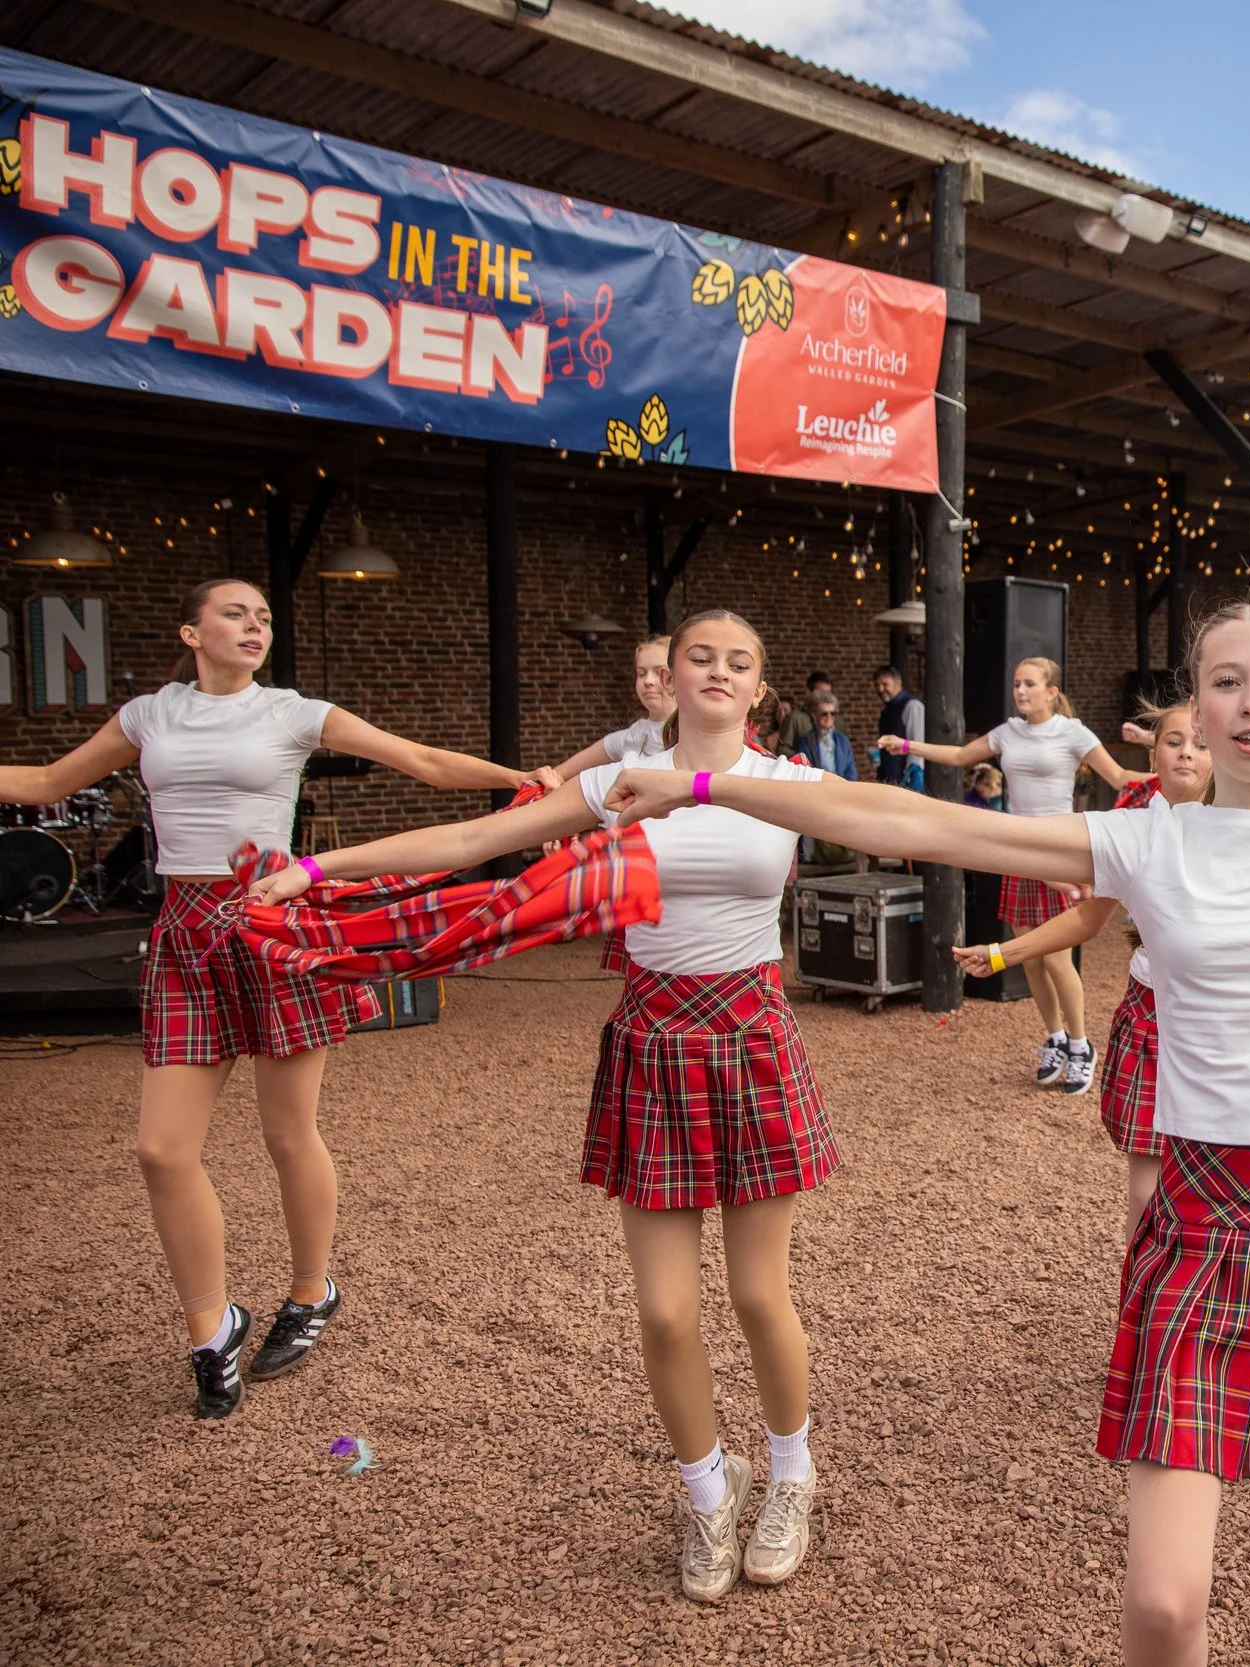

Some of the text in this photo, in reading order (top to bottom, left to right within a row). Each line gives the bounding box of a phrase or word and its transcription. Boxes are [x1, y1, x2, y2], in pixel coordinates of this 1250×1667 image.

[19, 112, 532, 305] HOPS IN THE
[11, 235, 549, 405] GARDEN
[800, 332, 907, 376] Archerfield
[808, 364, 897, 390] WALLED GARDEN
[796, 403, 898, 446] Leuchie
[800, 435, 893, 459] Reimagining Respite
